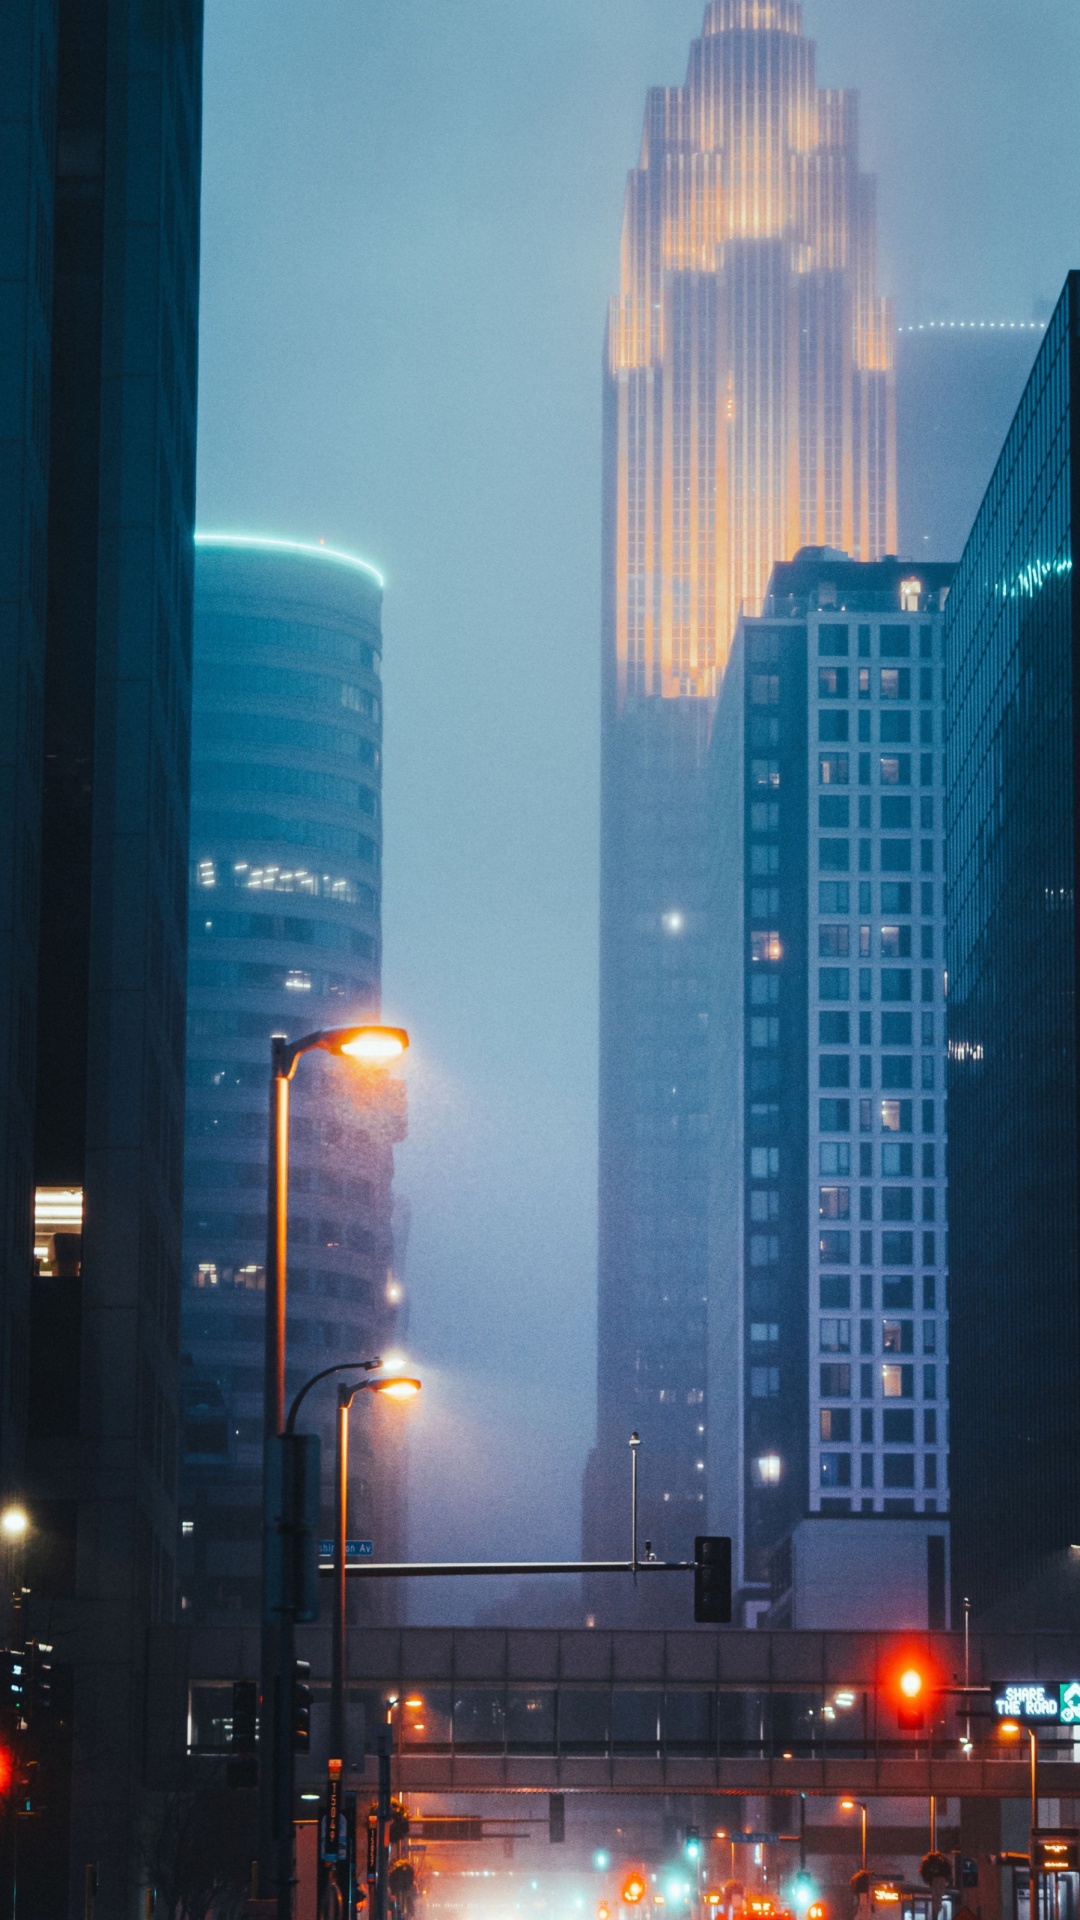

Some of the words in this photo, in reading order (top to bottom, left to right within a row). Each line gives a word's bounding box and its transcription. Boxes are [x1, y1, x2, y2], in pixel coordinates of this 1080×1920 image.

[359, 1543, 371, 1553] Av
[1006, 1687, 1045, 1702] SHARE
[995, 1700, 1021, 1715] THE
[1025, 1700, 1058, 1715] ROAD
